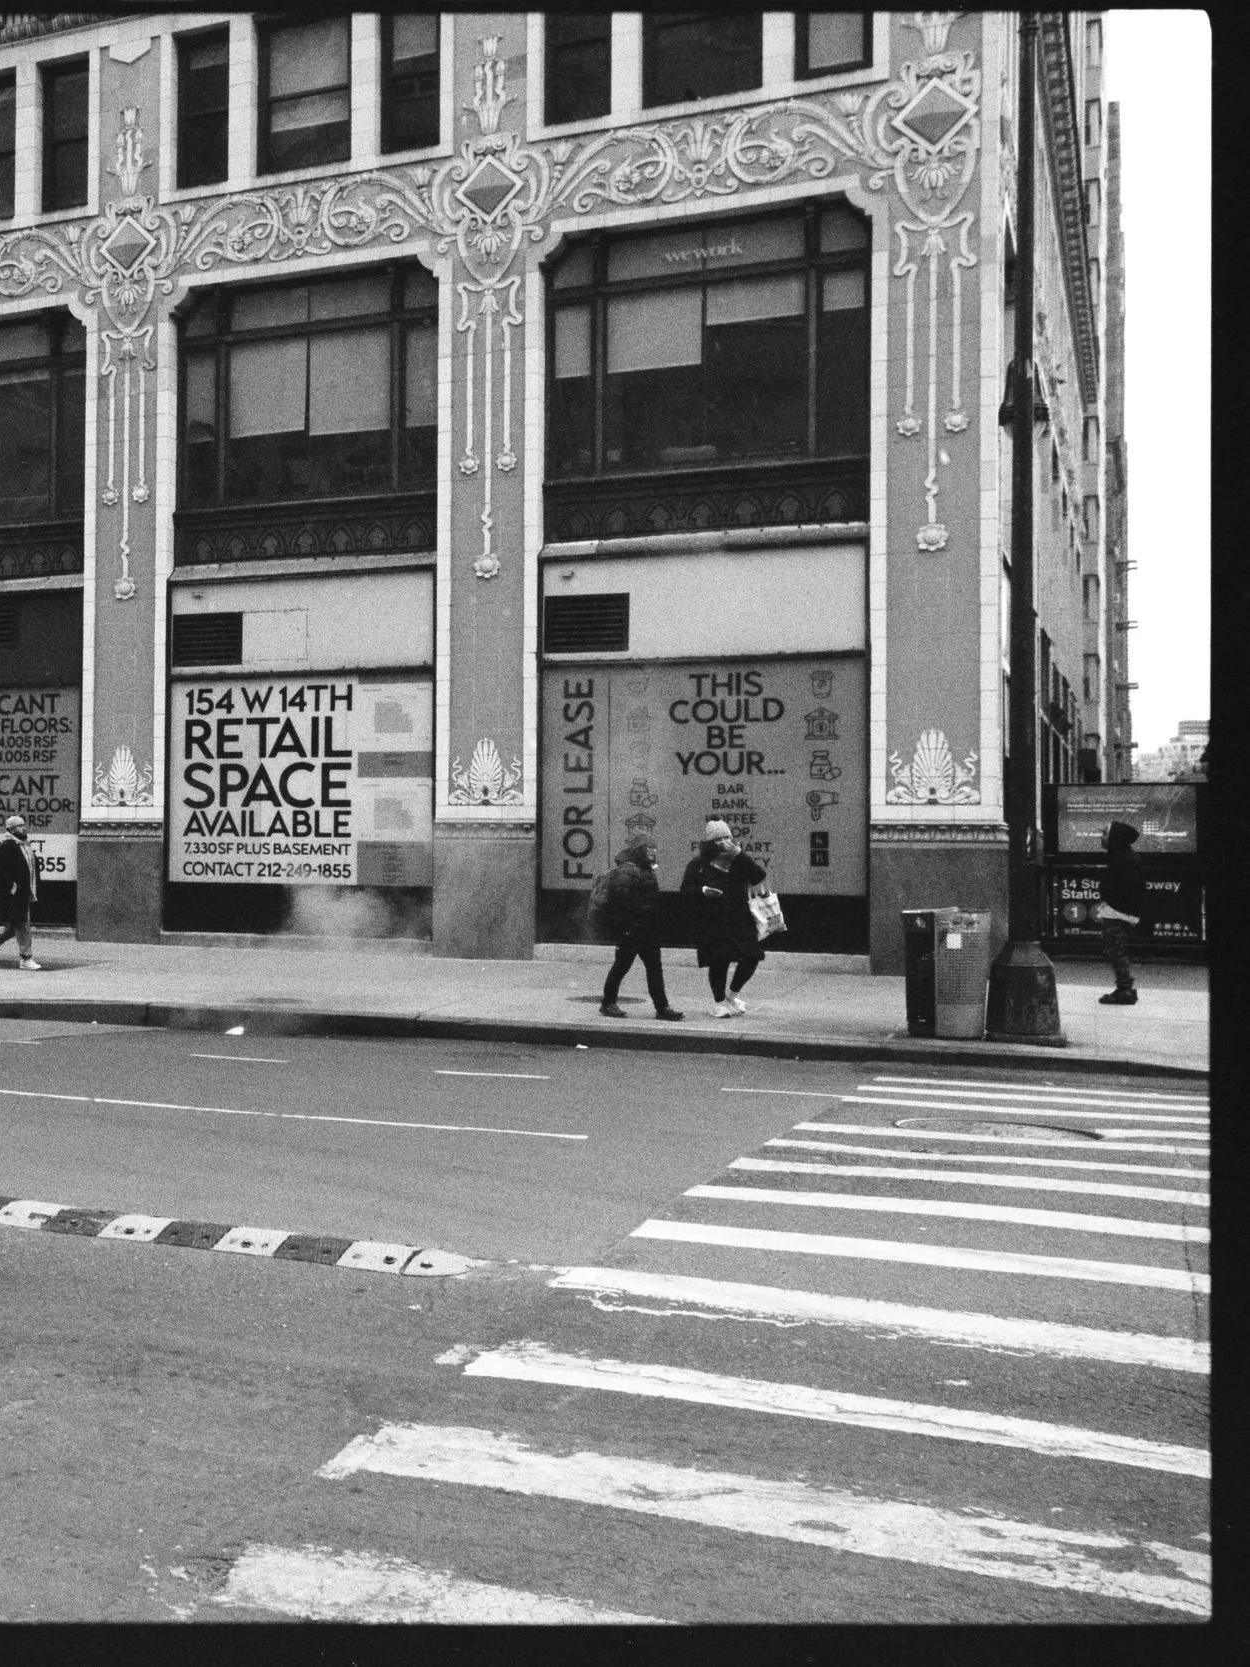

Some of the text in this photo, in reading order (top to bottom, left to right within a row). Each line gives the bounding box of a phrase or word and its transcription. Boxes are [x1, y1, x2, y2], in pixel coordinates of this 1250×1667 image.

[664, 238, 744, 263] wework
[689, 671, 764, 697] THIS
[185, 687, 235, 715] 154
[241, 686, 274, 714] W
[279, 684, 353, 712] 14TH
[669, 698, 786, 724] COULD
[1, 716, 73, 734] FLOORS:
[707, 724, 748, 749] BE
[33, 735, 58, 748] RSF
[184, 716, 353, 760] RETAIL
[32, 750, 57, 763] RSF
[675, 751, 786, 776] YOUR...
[182, 761, 352, 810] SPACE
[563, 678, 594, 880] FOR LEASE
[18, 797, 75, 813] FLOOR:
[28, 814, 53, 827] RSF
[182, 810, 352, 838] AVAILABLE
[236, 842, 271, 855] PLUS
[273, 843, 352, 856] BASEMENT
[182, 861, 353, 879] CONTACT 212-249-1855
[1061, 879, 1077, 889] 14
[1081, 878, 1101, 889] Str
